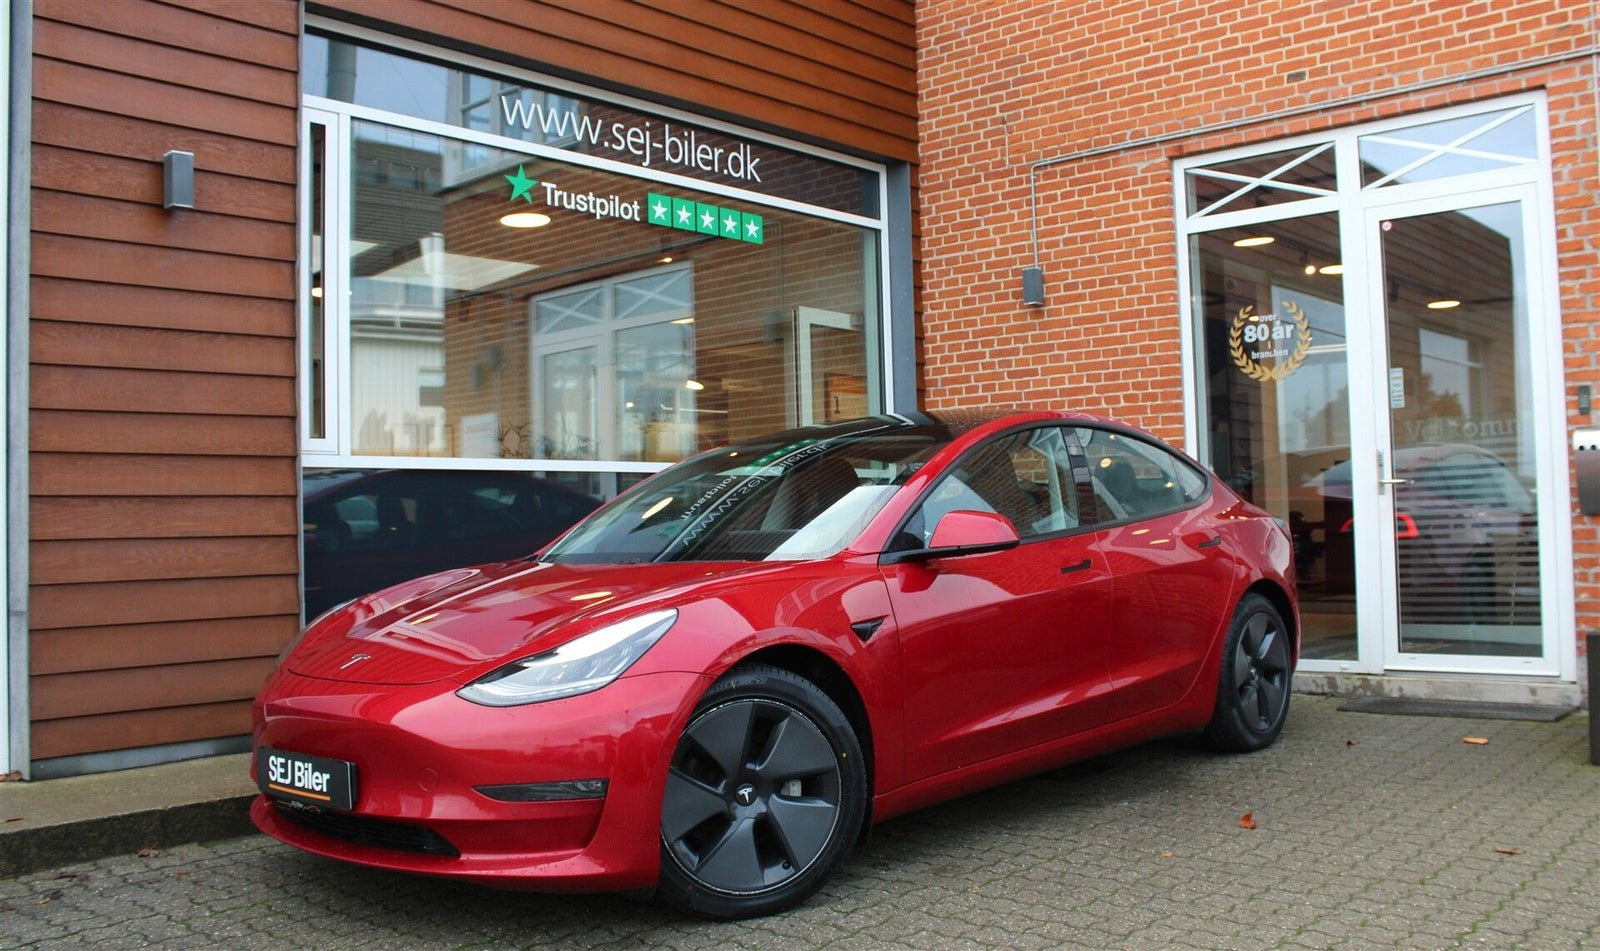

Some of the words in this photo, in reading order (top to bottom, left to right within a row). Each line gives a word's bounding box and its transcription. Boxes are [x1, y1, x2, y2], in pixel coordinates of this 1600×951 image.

[501, 95, 762, 183] www.sej-biler.dk
[541, 181, 641, 222] Trustpilot
[1244, 323, 1270, 343] 80
[1272, 320, 1295, 340] år
[1259, 313, 1277, 322] over
[1251, 348, 1289, 359] branchen
[268, 755, 292, 785] SEJ
[294, 761, 331, 792] Biler
